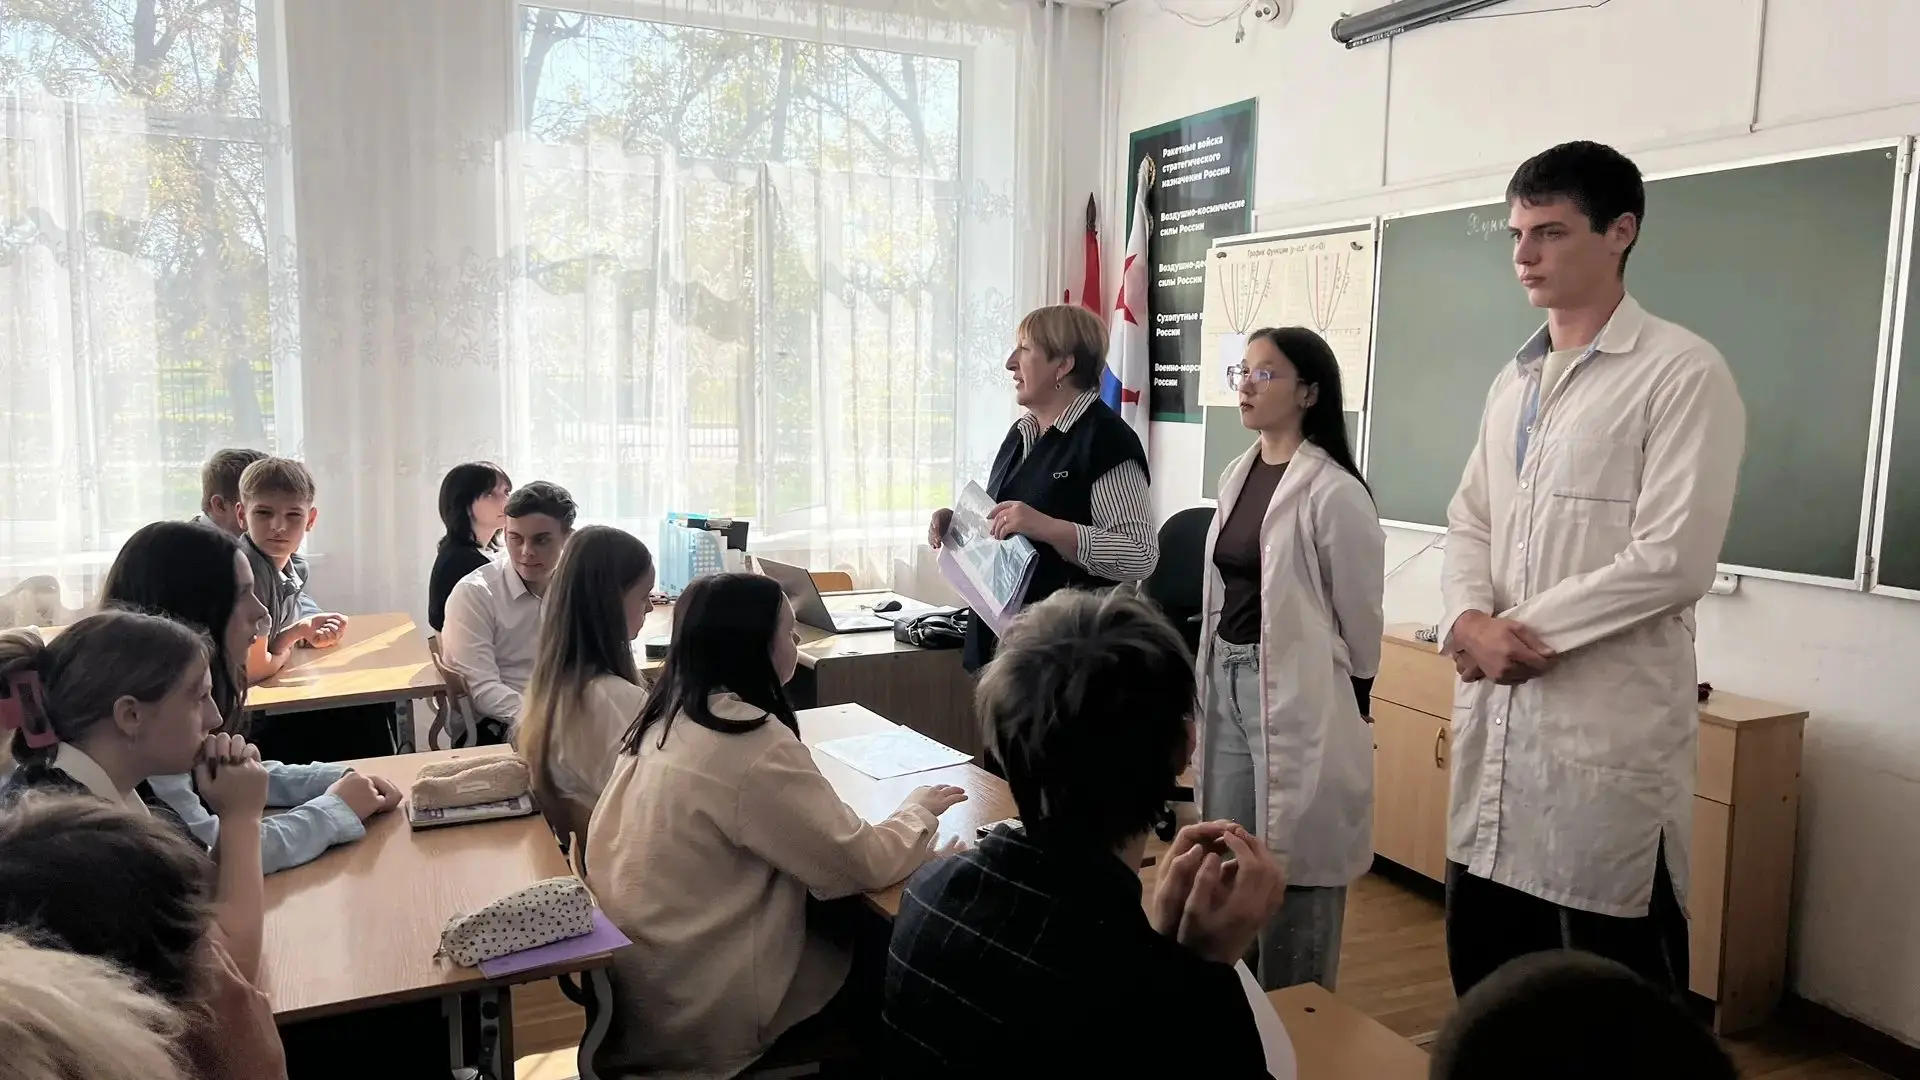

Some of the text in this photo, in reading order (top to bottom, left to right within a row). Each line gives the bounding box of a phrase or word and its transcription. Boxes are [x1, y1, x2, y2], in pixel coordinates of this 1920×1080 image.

[1163, 136, 1223, 158] Ракетные войска
[1162, 152, 1221, 173] стратегического
[1161, 166, 1230, 188] назначения России
[1160, 199, 1246, 222] Воздушно-космические
[1160, 222, 1205, 236] силы России
[1158, 275, 1203, 287] силы России
[1156, 312, 1198, 324] Сухопутные
[1156, 328, 1181, 337] России
[1153, 377, 1178, 387] России
